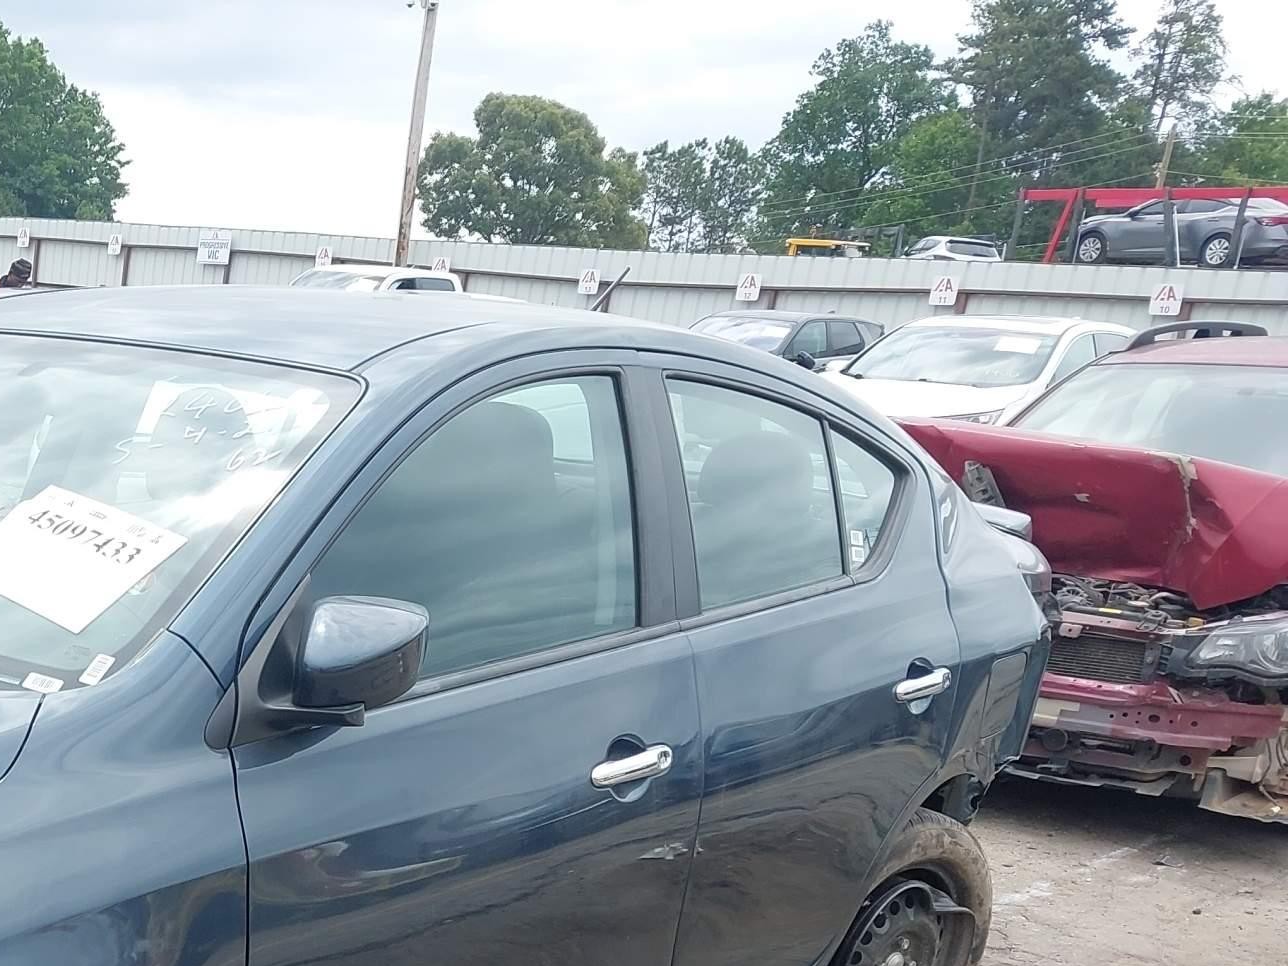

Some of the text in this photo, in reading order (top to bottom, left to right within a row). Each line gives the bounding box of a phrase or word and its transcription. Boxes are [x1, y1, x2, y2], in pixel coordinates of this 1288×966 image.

[207, 249, 220, 260] VIC
[1159, 306, 1170, 314] 10
[27, 508, 142, 565] 45097433
